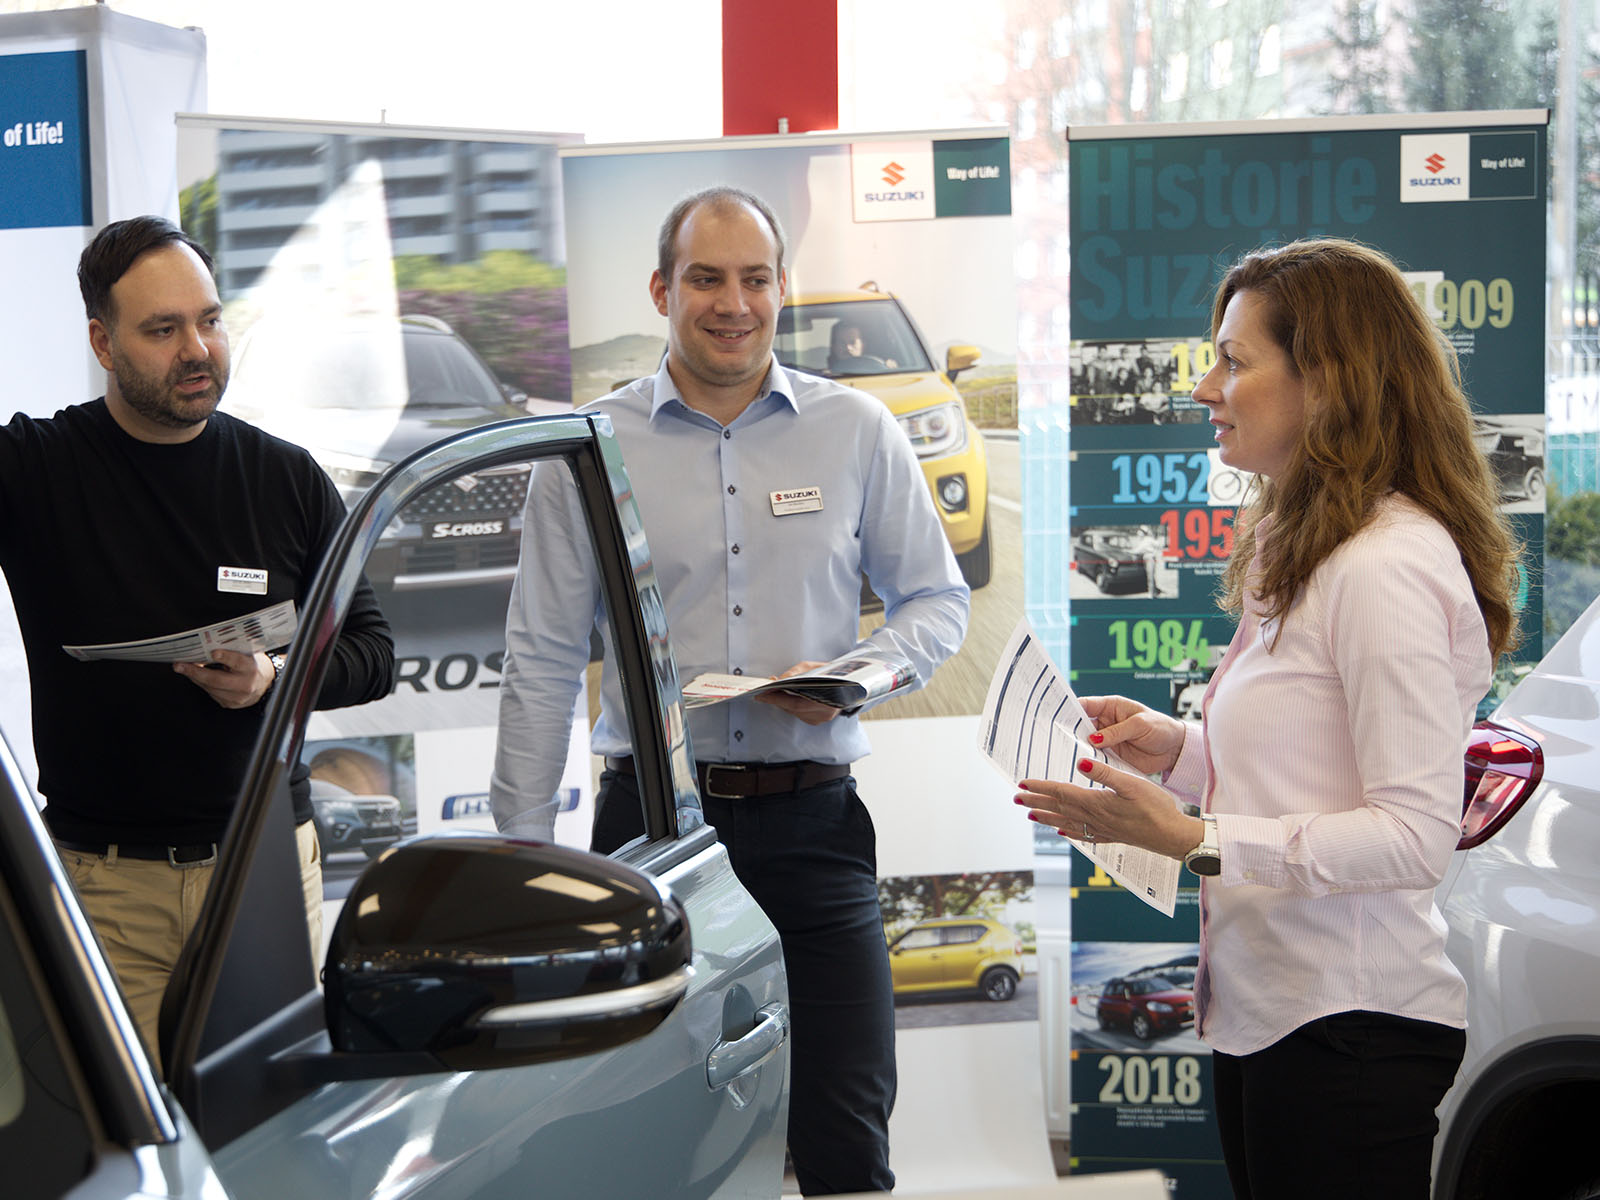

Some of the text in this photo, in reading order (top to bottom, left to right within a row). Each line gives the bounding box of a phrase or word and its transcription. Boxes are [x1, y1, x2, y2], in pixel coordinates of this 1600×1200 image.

[4, 120, 64, 147] of Life!
[946, 165, 1000, 182] Way of Life!
[1480, 157, 1526, 170] Way of Life!
[1080, 138, 1378, 232] Historie
[1409, 177, 1461, 187] SUZUKI
[864, 191, 925, 203] SUZUKI
[1170, 341, 1217, 392] 19
[1112, 452, 1211, 504] 1952
[783, 490, 818, 500] SUZUKI
[1160, 508, 1238, 559] 195
[231, 571, 266, 581] SUZUKI
[1108, 619, 1211, 669] 1984
[1098, 1054, 1202, 1106] 2018
